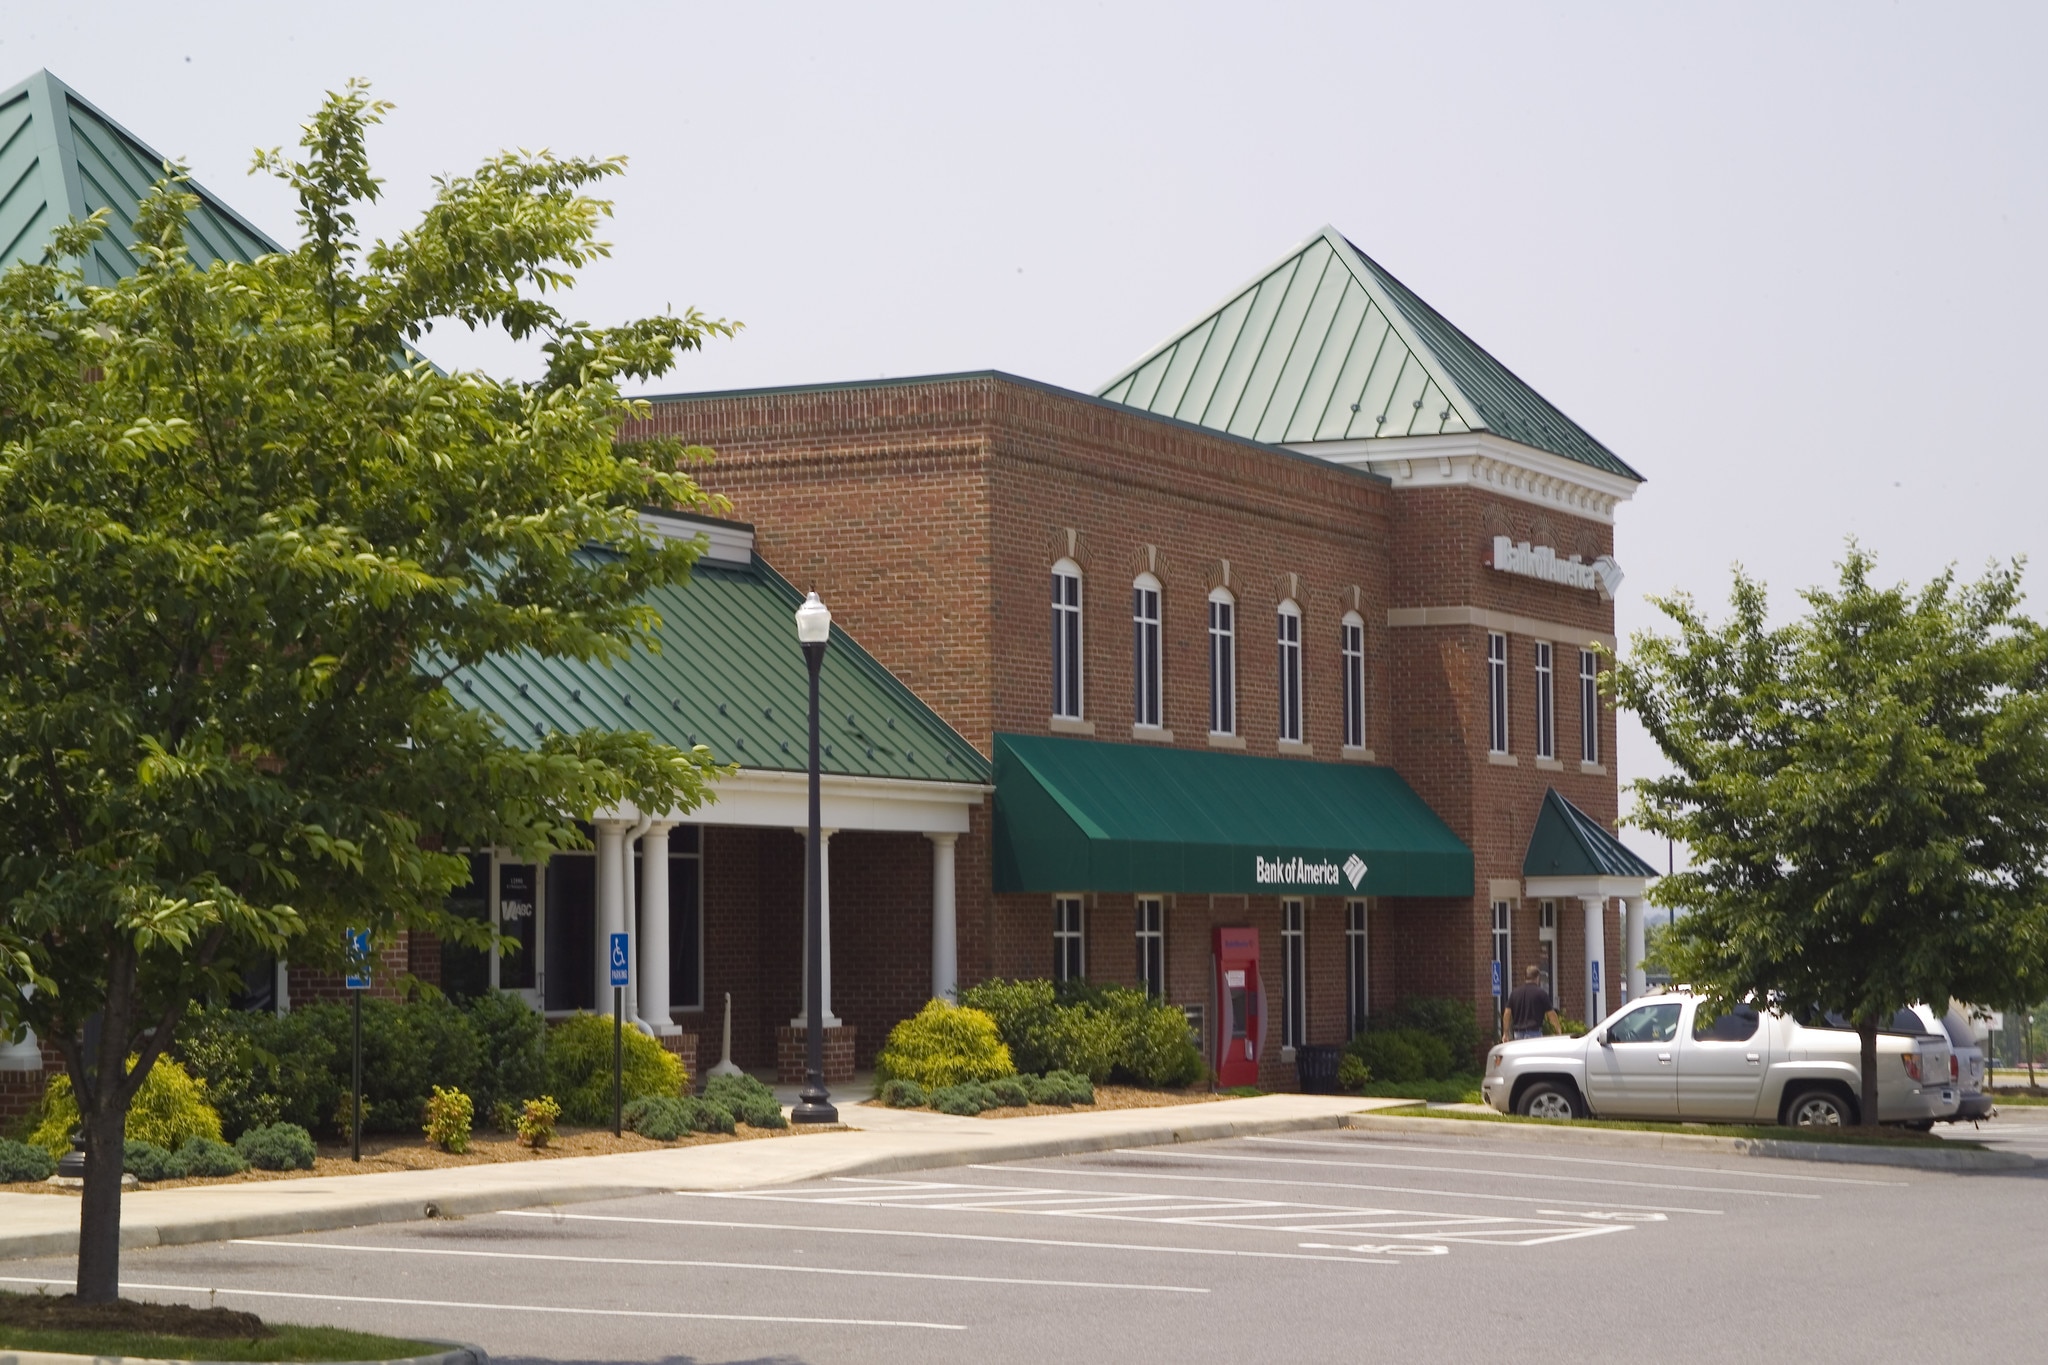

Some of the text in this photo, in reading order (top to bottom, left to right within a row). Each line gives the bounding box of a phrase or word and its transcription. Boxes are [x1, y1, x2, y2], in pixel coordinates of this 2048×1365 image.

[1493, 536, 1534, 575] Bank
[1548, 548, 1595, 590] America
[1256, 856, 1340, 885] Bank of America
